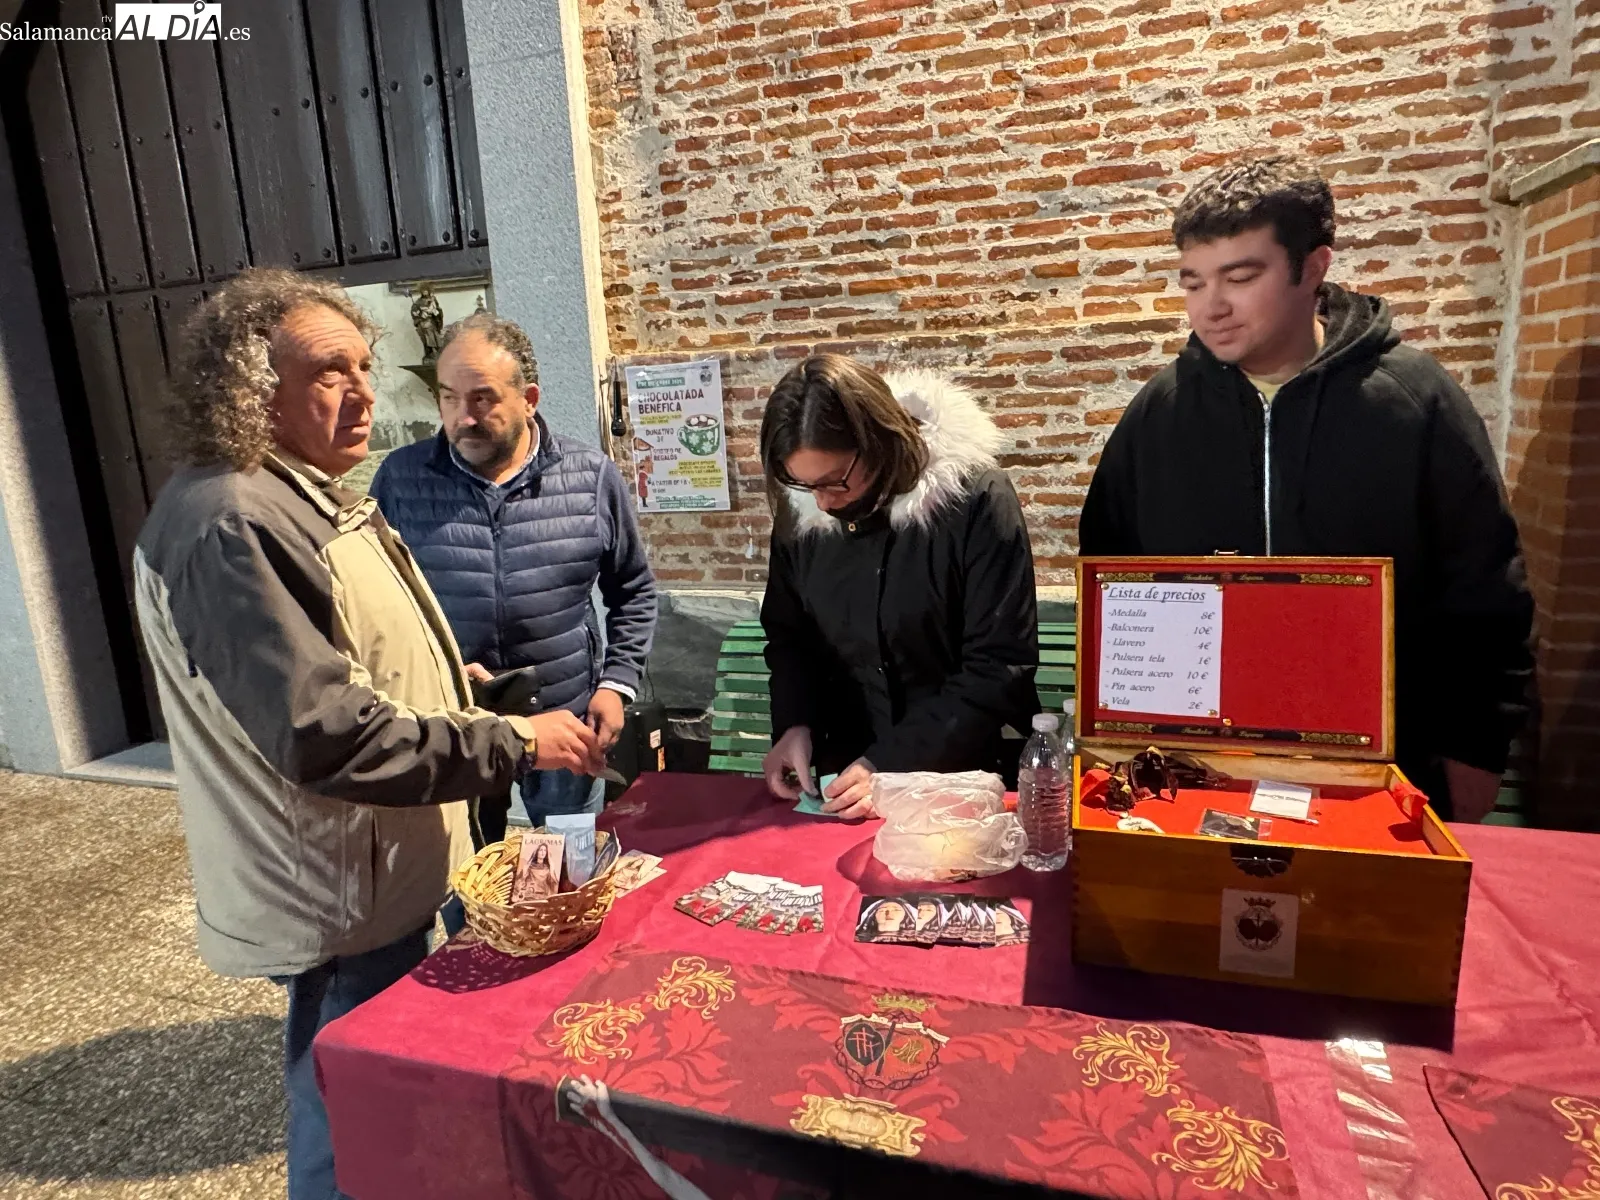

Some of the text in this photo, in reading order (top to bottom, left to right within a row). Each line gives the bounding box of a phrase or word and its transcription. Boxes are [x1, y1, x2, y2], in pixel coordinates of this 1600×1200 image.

[638, 388, 704, 404] CHOCOLATADA
[1108, 586, 1206, 603] Lista de precios
[1112, 638, 1145, 647] Llavero
[1197, 642, 1212, 650] 4€
[1112, 653, 1144, 662] Pulsera
[1148, 654, 1165, 663] tela
[1111, 668, 1143, 677] Pulsera
[1111, 682, 1125, 690] Pin
[1188, 686, 1202, 694] 6€
[1112, 697, 1130, 705] Vela
[1188, 701, 1202, 710] 2€
